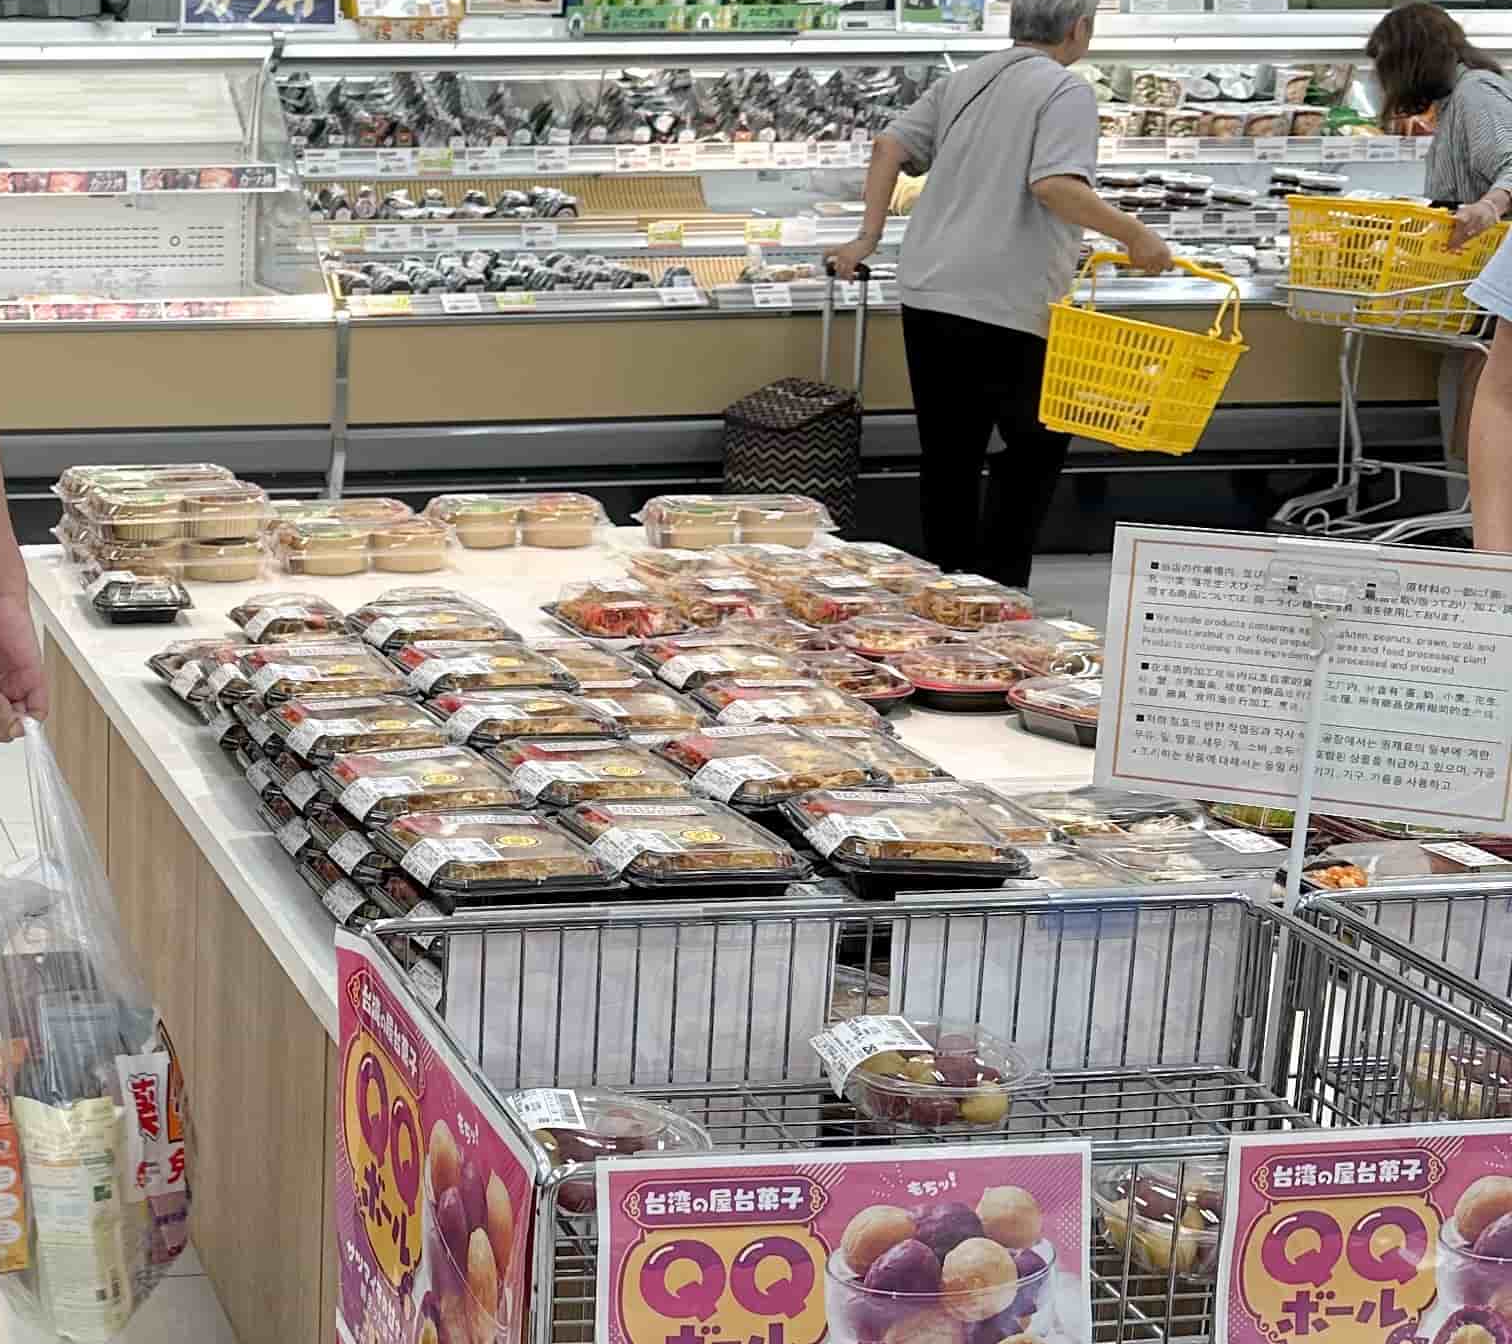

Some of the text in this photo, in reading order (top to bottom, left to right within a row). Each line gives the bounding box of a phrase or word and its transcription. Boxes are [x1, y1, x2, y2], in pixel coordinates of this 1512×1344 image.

[1204, 617, 1245, 630] products
[1257, 633, 1277, 644] food
[1383, 645, 1404, 656] food
[356, 1051, 421, 1218] QQ
[1272, 1159, 1424, 1188] 台湾の屋台菓子
[644, 1186, 804, 1215] 台湾の屋台菓子
[1261, 1206, 1428, 1288] QQ
[639, 1236, 815, 1322] QQ
[1276, 1289, 1408, 1335] ボール
